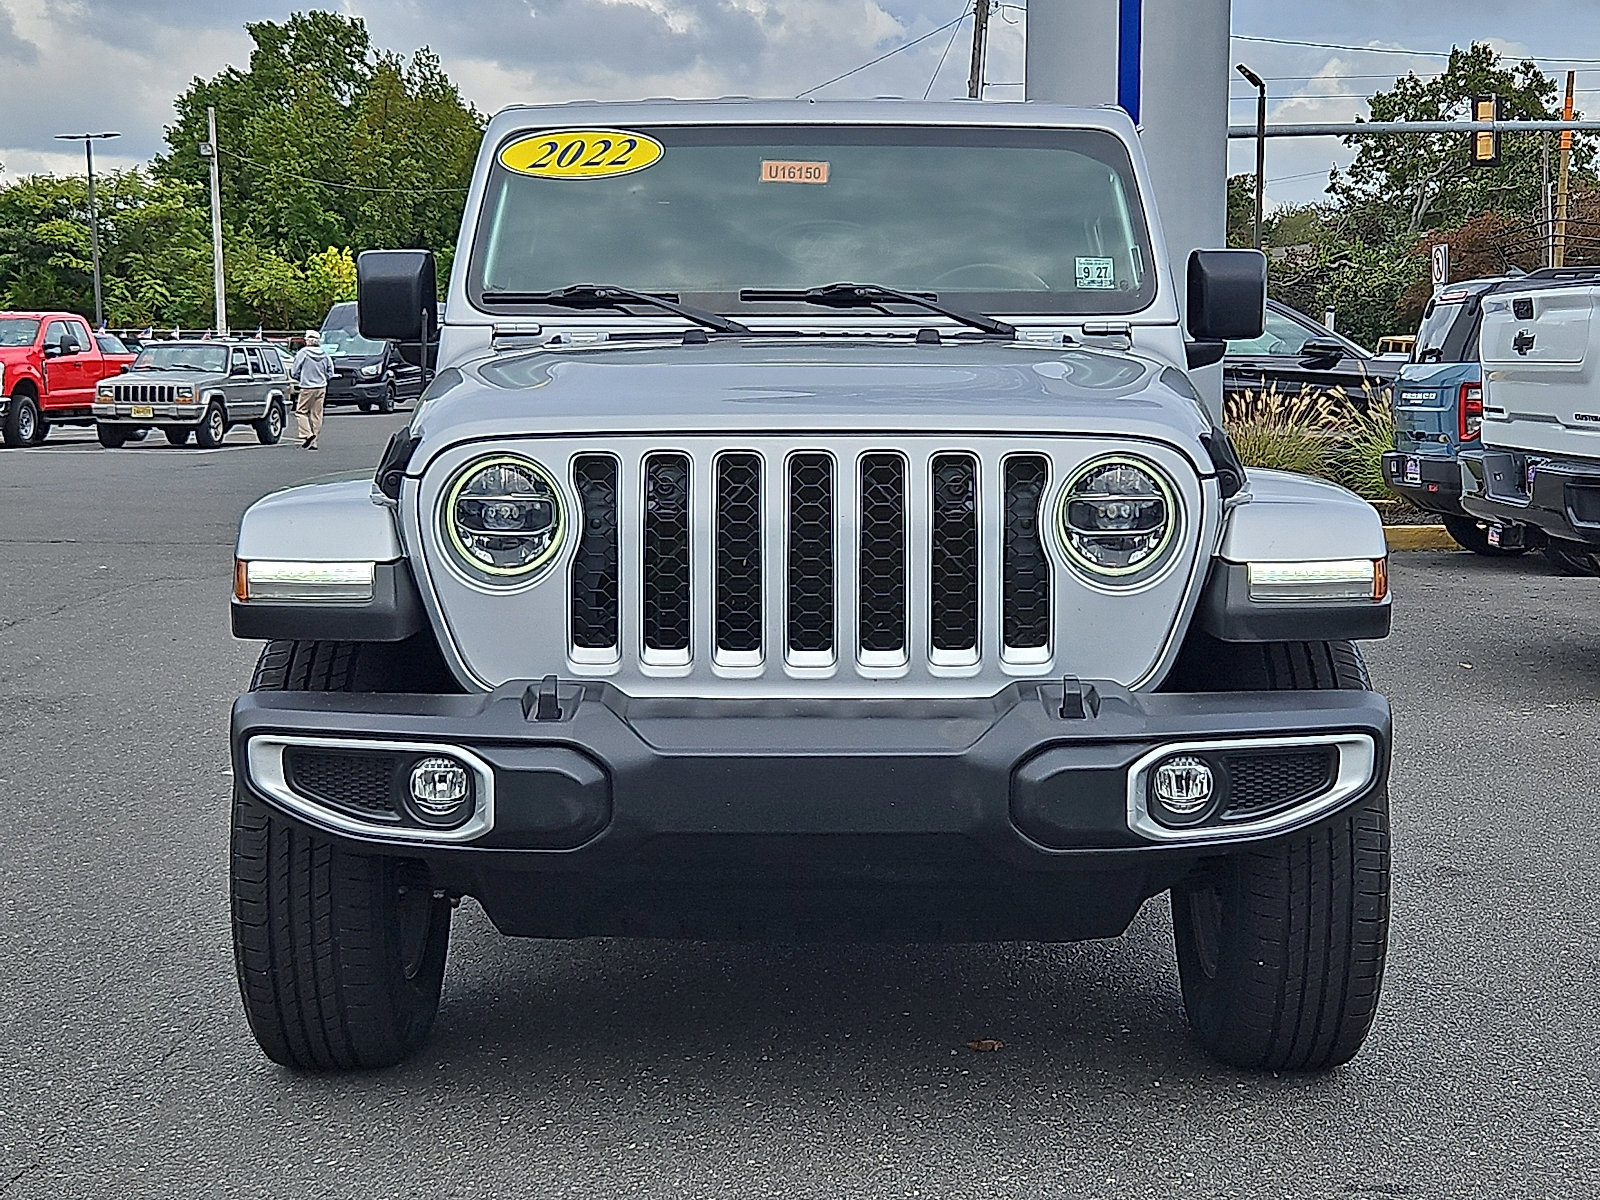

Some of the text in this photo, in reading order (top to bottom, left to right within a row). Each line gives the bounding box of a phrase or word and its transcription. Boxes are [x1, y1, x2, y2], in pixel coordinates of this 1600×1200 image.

[526, 138, 638, 170] 2022
[769, 165, 822, 179] U16150
[1083, 266, 1109, 279] 9 27
